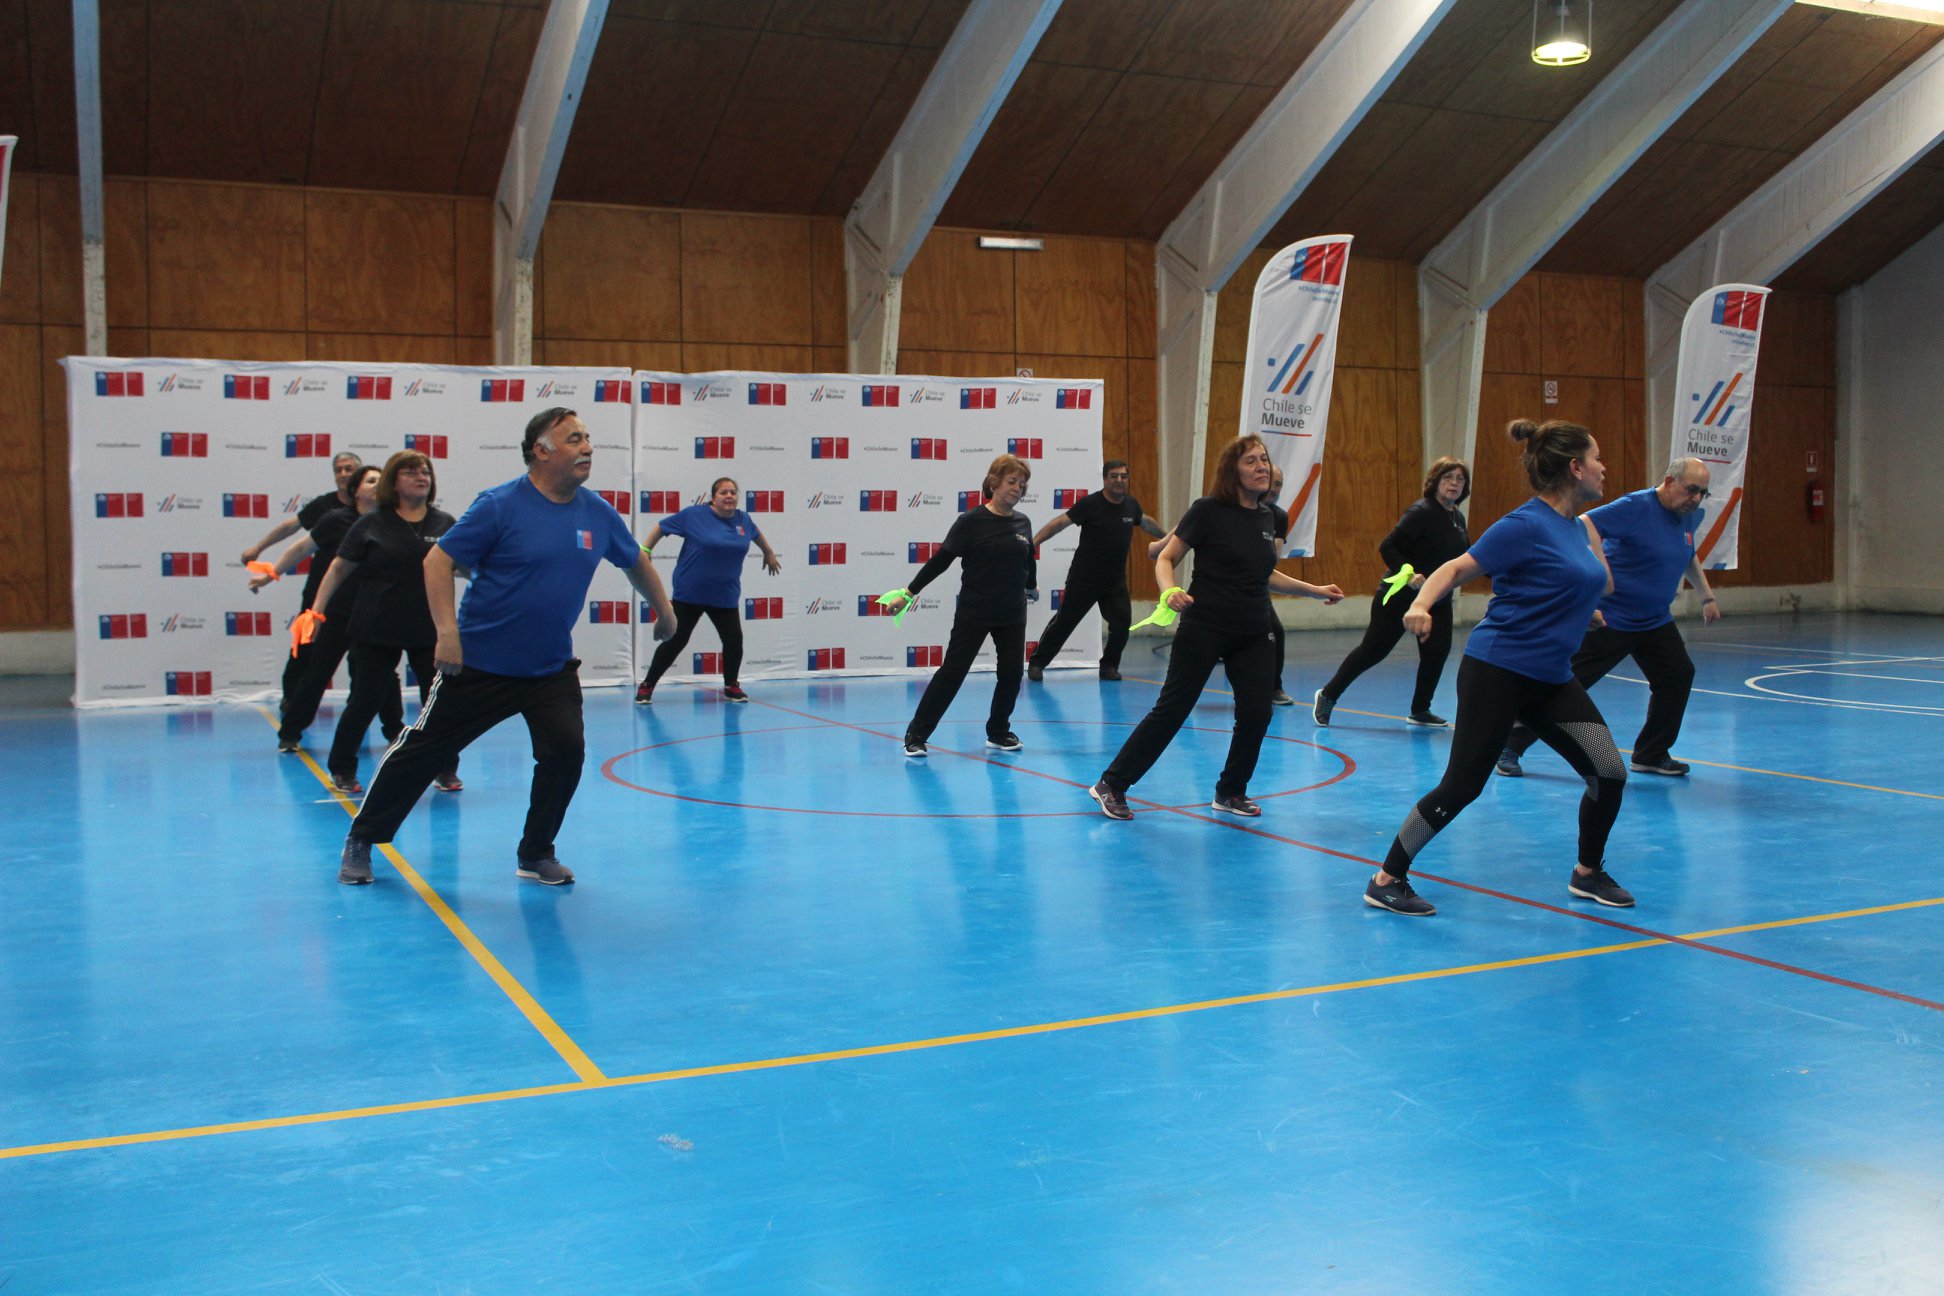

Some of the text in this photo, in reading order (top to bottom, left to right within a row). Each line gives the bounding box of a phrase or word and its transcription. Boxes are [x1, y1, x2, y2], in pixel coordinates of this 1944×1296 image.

[1263, 398, 1312, 415] Chile se
[1261, 413, 1304, 429] Mueve
[1688, 428, 1734, 444] Chile se
[1687, 442, 1728, 456] Mueve
